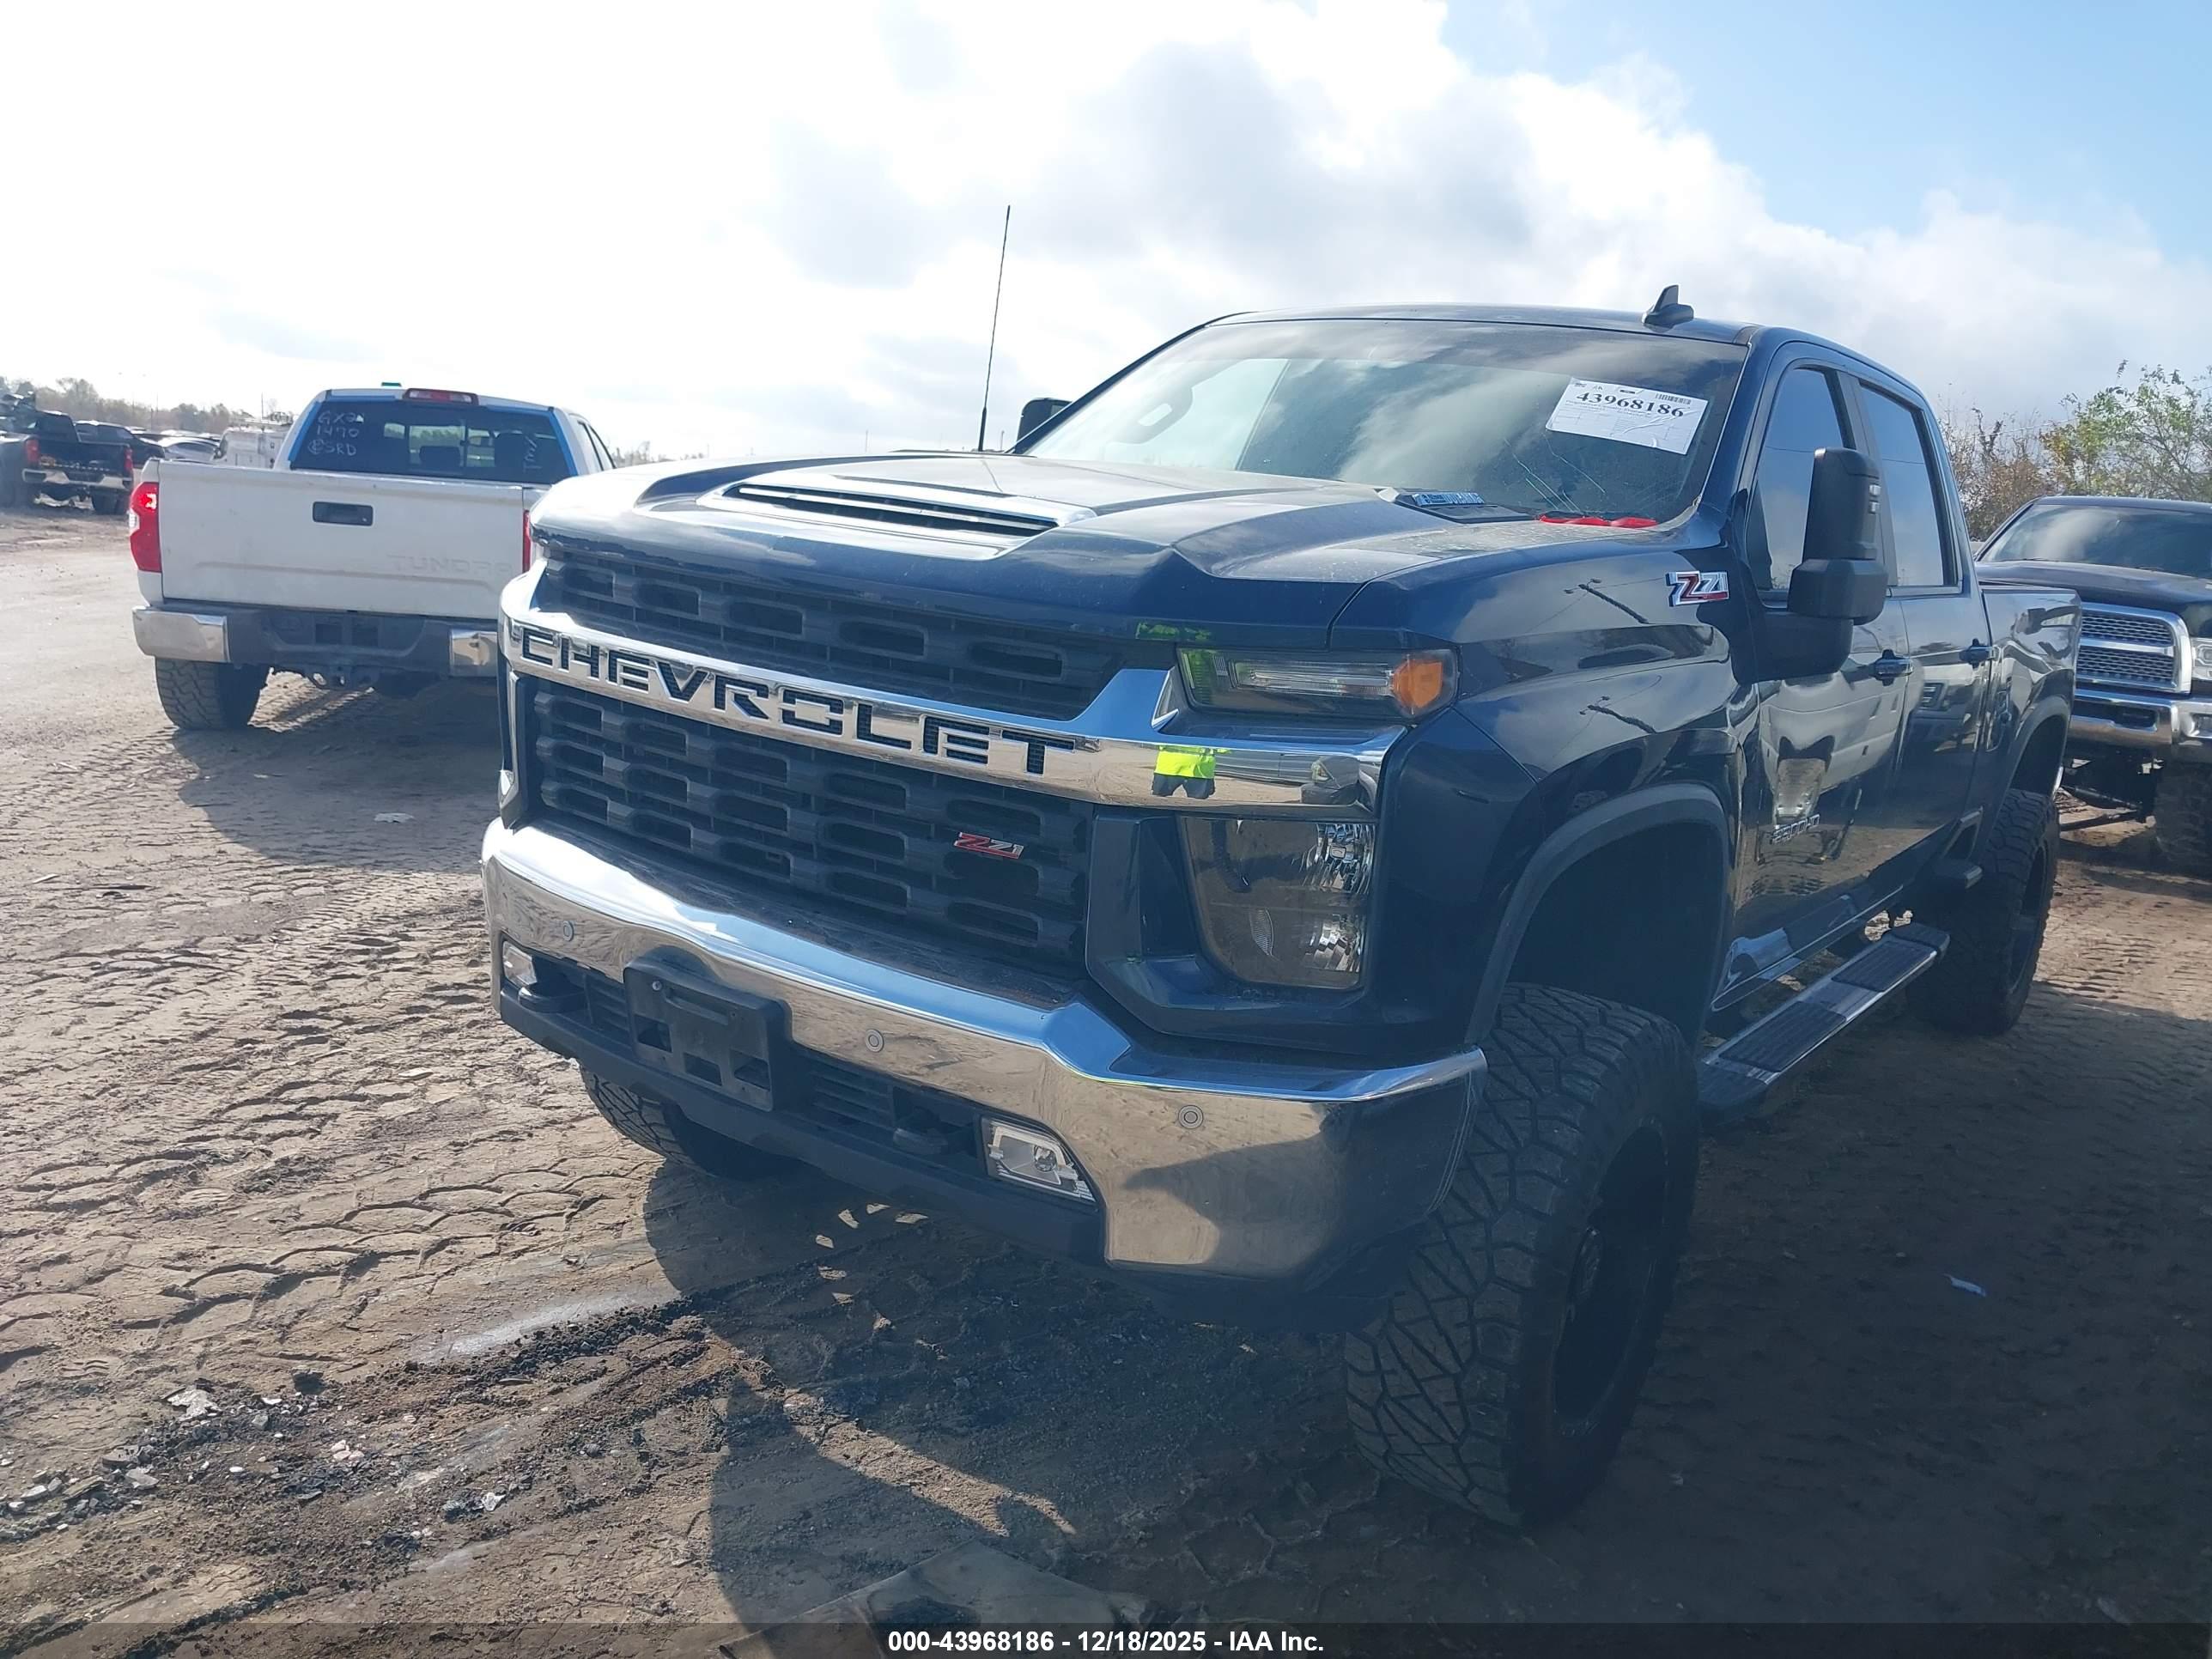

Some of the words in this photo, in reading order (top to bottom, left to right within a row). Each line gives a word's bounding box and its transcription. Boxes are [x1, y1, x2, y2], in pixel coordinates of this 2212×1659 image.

[1577, 392, 1690, 418] 43968186
[386, 552, 514, 577] TUNDRA
[1665, 570, 1729, 606] Z71
[521, 627, 1076, 775] CHEVROLET
[953, 831, 1024, 860] Z71
